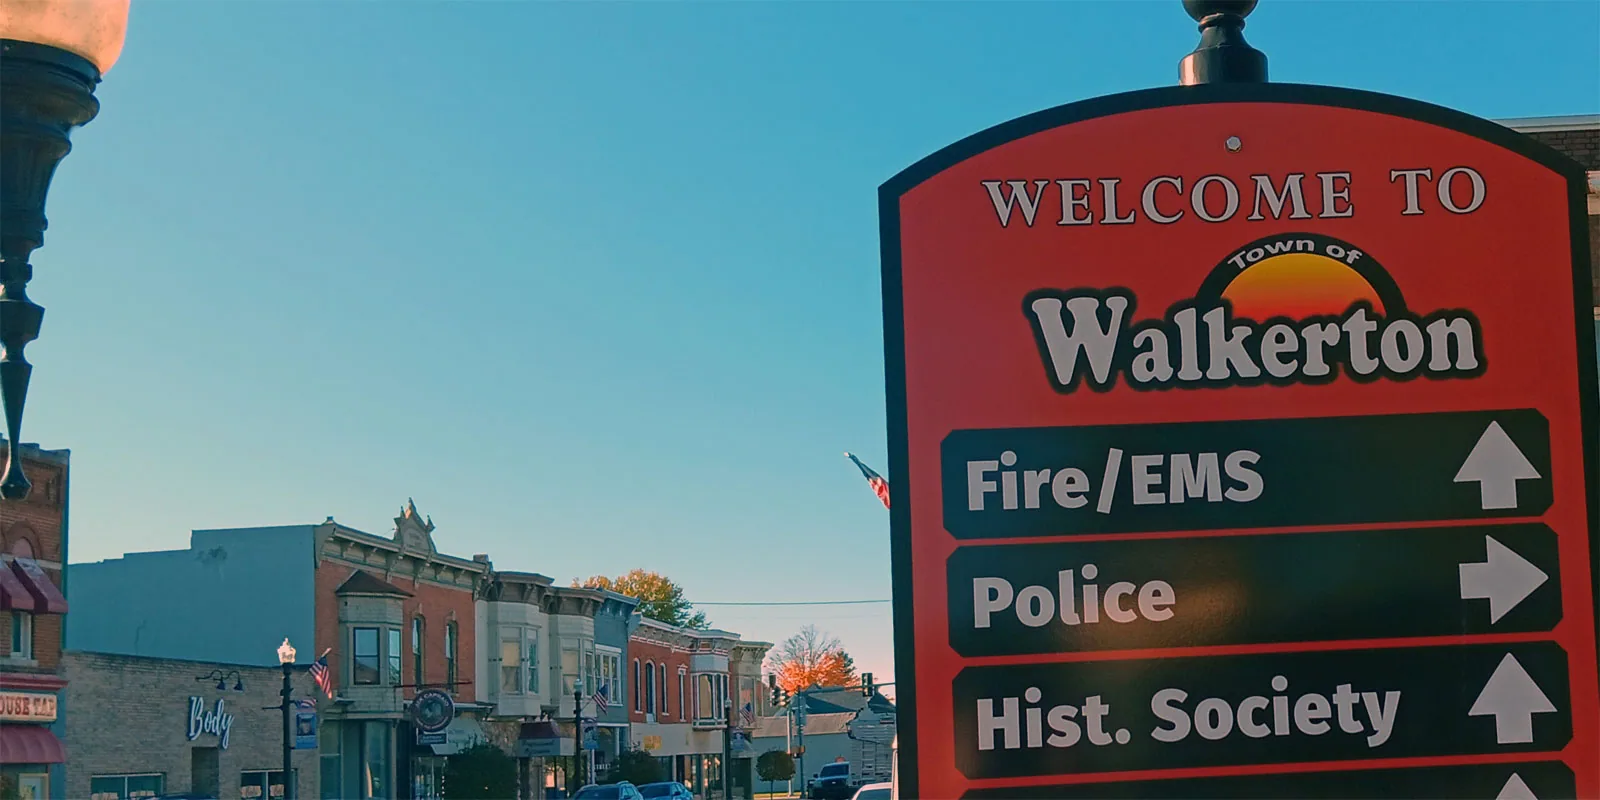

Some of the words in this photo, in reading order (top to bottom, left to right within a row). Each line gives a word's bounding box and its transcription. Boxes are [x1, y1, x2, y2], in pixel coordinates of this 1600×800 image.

[980, 173, 1354, 227] WELCOME
[1390, 166, 1486, 216] TO
[1227, 238, 1316, 270] Town
[1325, 243, 1364, 265] of
[1030, 295, 1480, 388] Walkerton
[965, 447, 1265, 515] Fire/EMS
[972, 563, 1177, 629] Police
[188, 695, 235, 750] Body
[976, 686, 1133, 752] Hist.
[1150, 675, 1401, 749] Society
